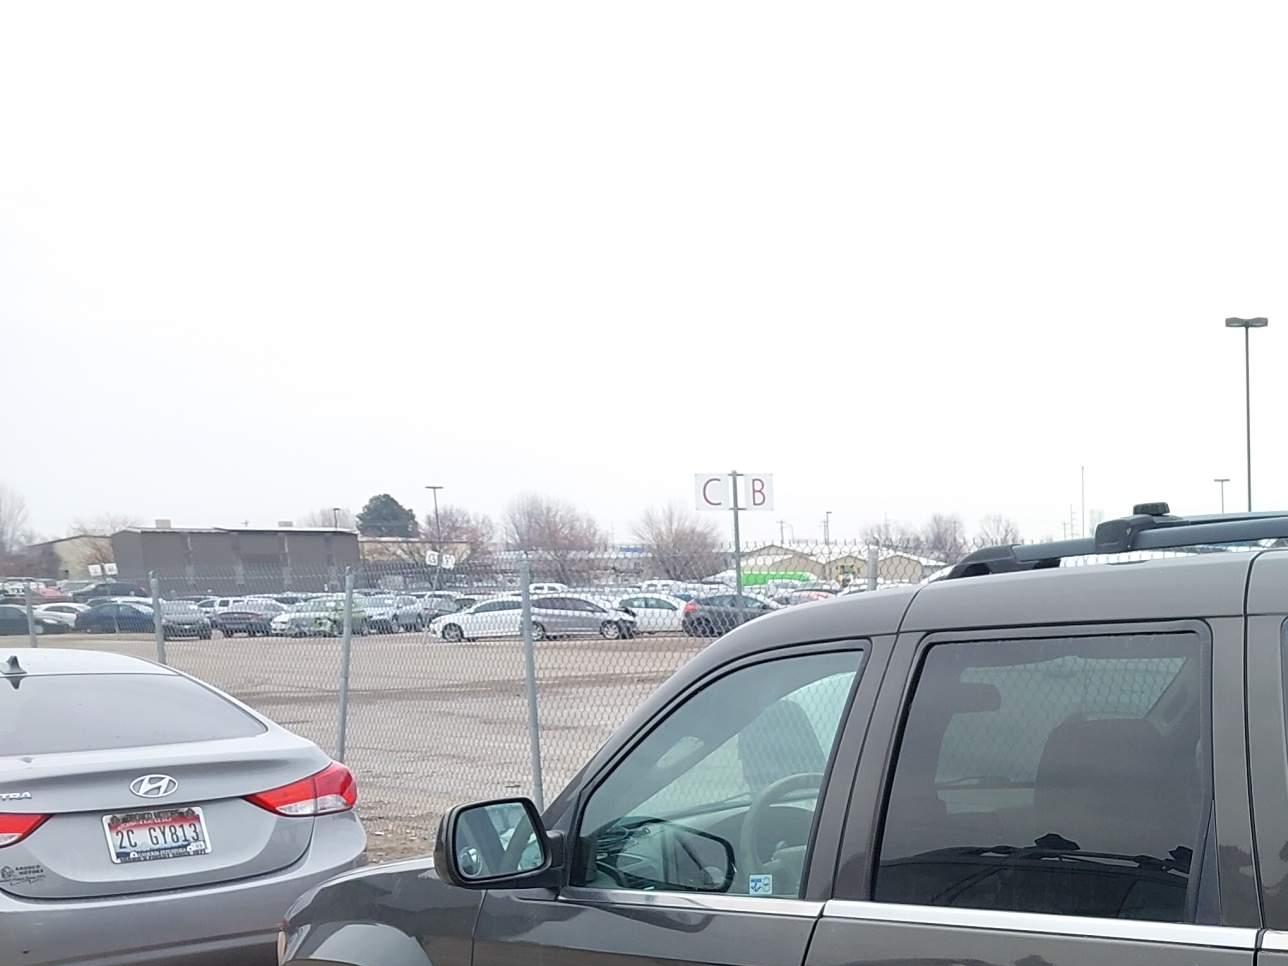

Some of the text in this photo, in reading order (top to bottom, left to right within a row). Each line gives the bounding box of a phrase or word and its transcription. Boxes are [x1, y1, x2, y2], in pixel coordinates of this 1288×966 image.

[703, 478, 722, 506] C
[752, 478, 766, 506] B
[116, 829, 137, 850] 2C
[148, 823, 200, 846] GY813
